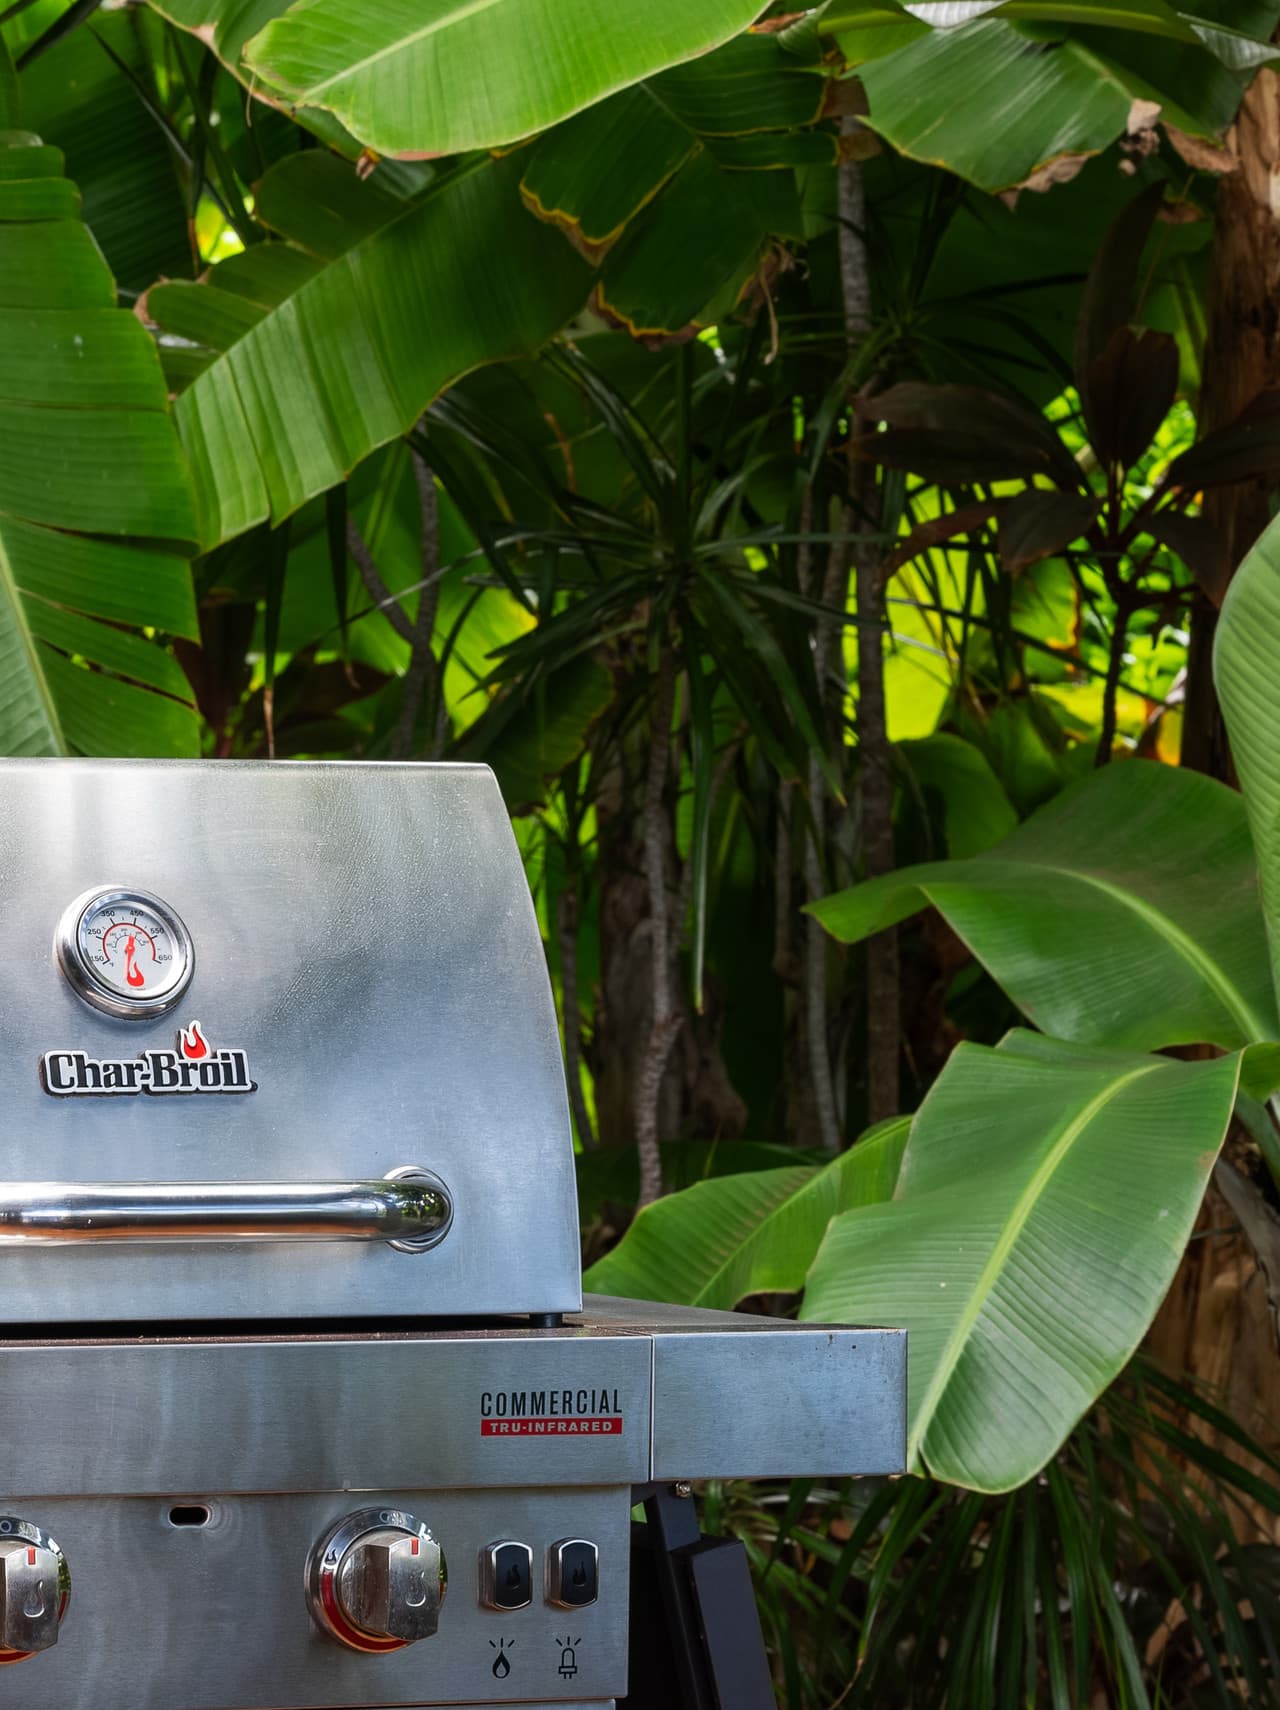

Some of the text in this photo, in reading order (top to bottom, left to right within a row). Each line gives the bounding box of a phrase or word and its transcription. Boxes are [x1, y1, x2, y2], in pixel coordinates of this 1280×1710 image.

[48, 1052, 248, 1089] Char-Broil
[480, 1389, 623, 1417] COMMERCIAL
[490, 1420, 613, 1433] TRU-INFRARED
